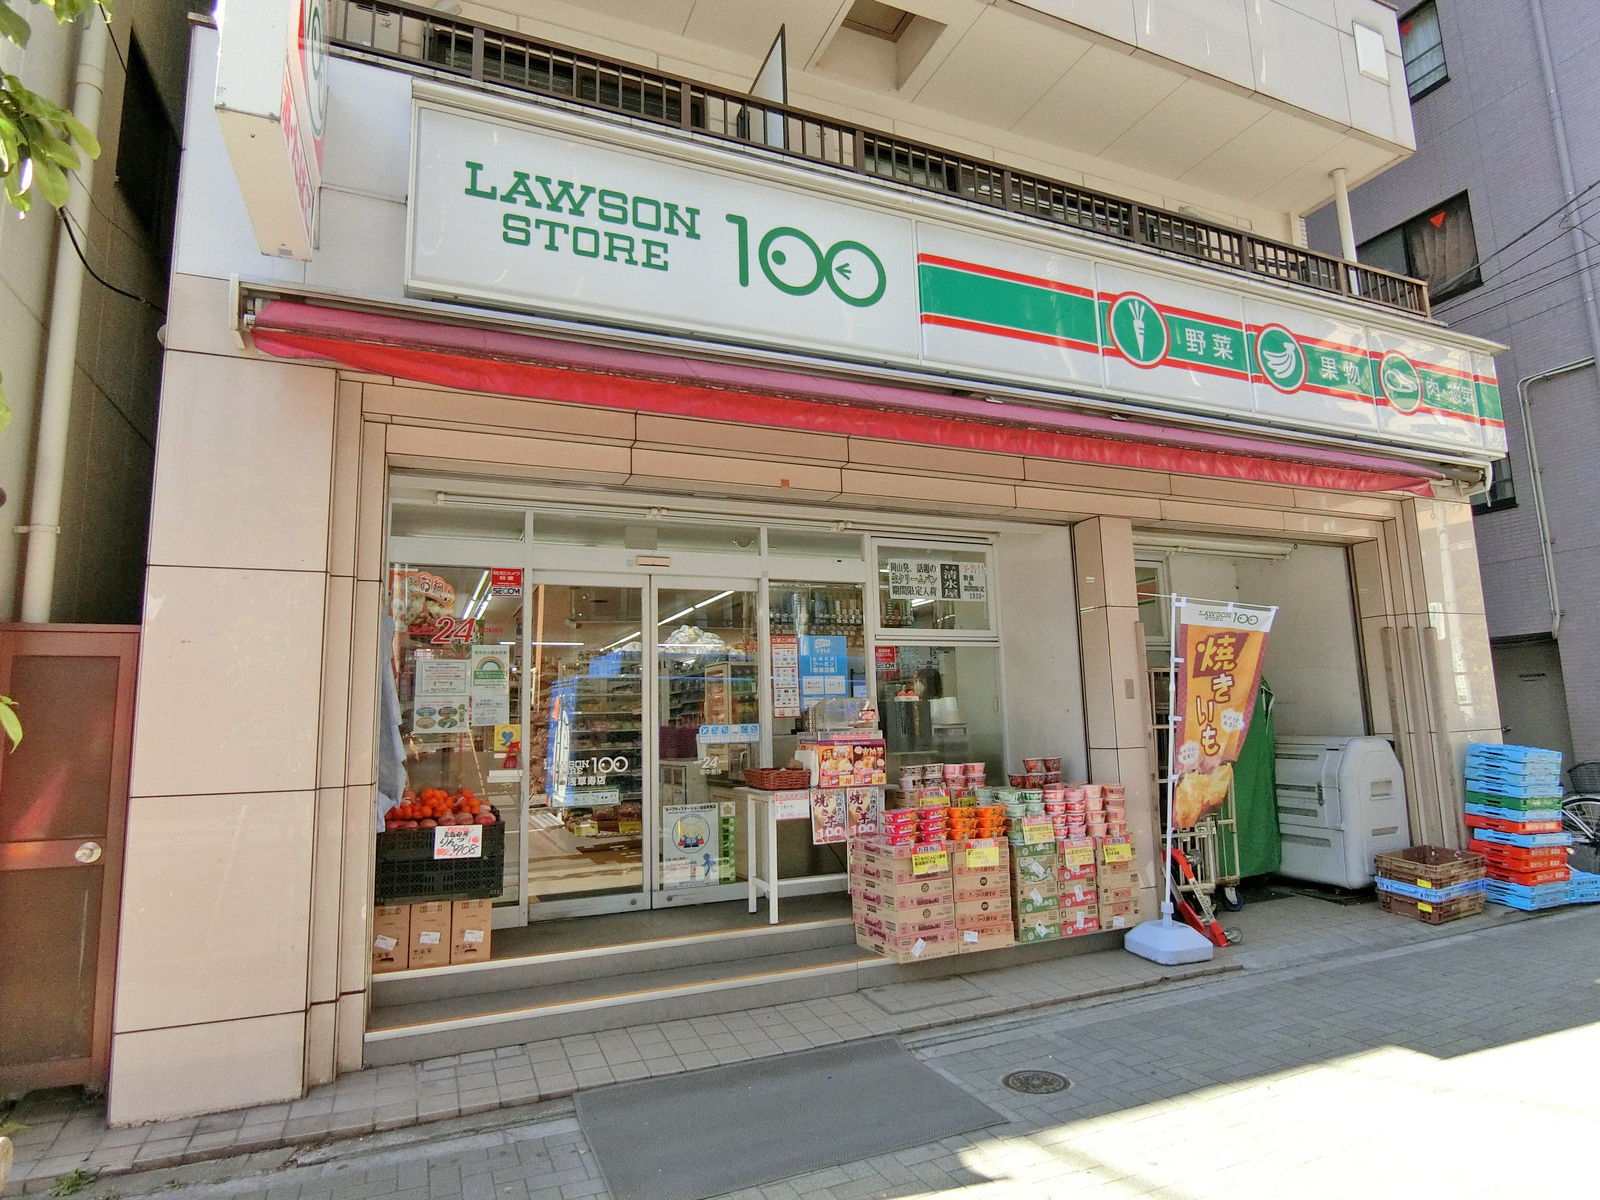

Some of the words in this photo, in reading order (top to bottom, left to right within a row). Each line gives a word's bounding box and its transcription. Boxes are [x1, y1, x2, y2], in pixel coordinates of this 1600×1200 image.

[465, 161, 701, 240] LAWSON
[502, 214, 669, 272] STORE
[726, 213, 887, 308] 100
[1184, 326, 1234, 361] 野菜
[1320, 356, 1362, 386] 果物
[892, 585, 938, 597] 期間限定入荷
[943, 570, 958, 598] 清水屋
[1198, 610, 1233, 618] LAWSON
[1233, 612, 1259, 625] 100
[431, 616, 477, 645] 24
[1196, 633, 1238, 757] 焼きいも
[591, 756, 628, 774] 100
[702, 756, 719, 768] 24
[817, 828, 843, 838] 100
[850, 823, 876, 834] 100
